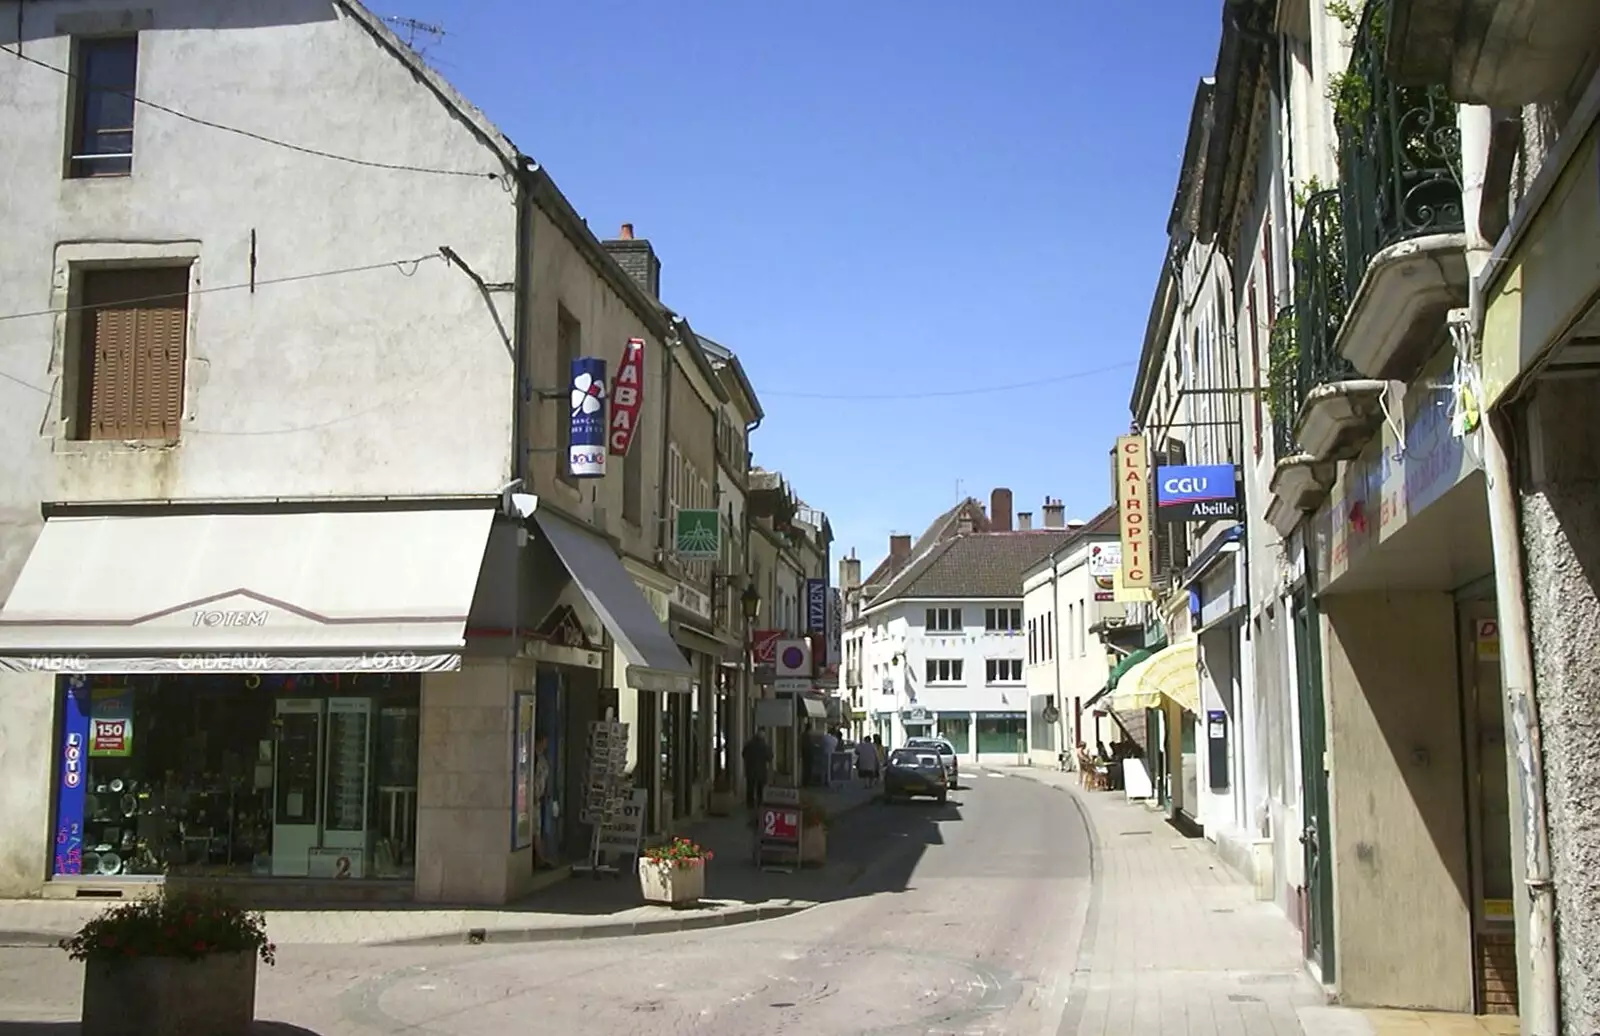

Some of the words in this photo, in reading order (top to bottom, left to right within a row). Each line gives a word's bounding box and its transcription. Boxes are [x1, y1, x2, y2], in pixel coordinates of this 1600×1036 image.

[611, 342, 642, 450] TABAC
[1164, 477, 1208, 493] CGU
[1124, 443, 1144, 581] CLAIROPTIC
[1192, 502, 1235, 515] Abeille
[193, 610, 270, 628] TOTEM
[178, 653, 270, 669] CADEAUX
[361, 651, 416, 668] LOTO
[97, 724, 122, 736] 150
[65, 733, 83, 787] LOTO
